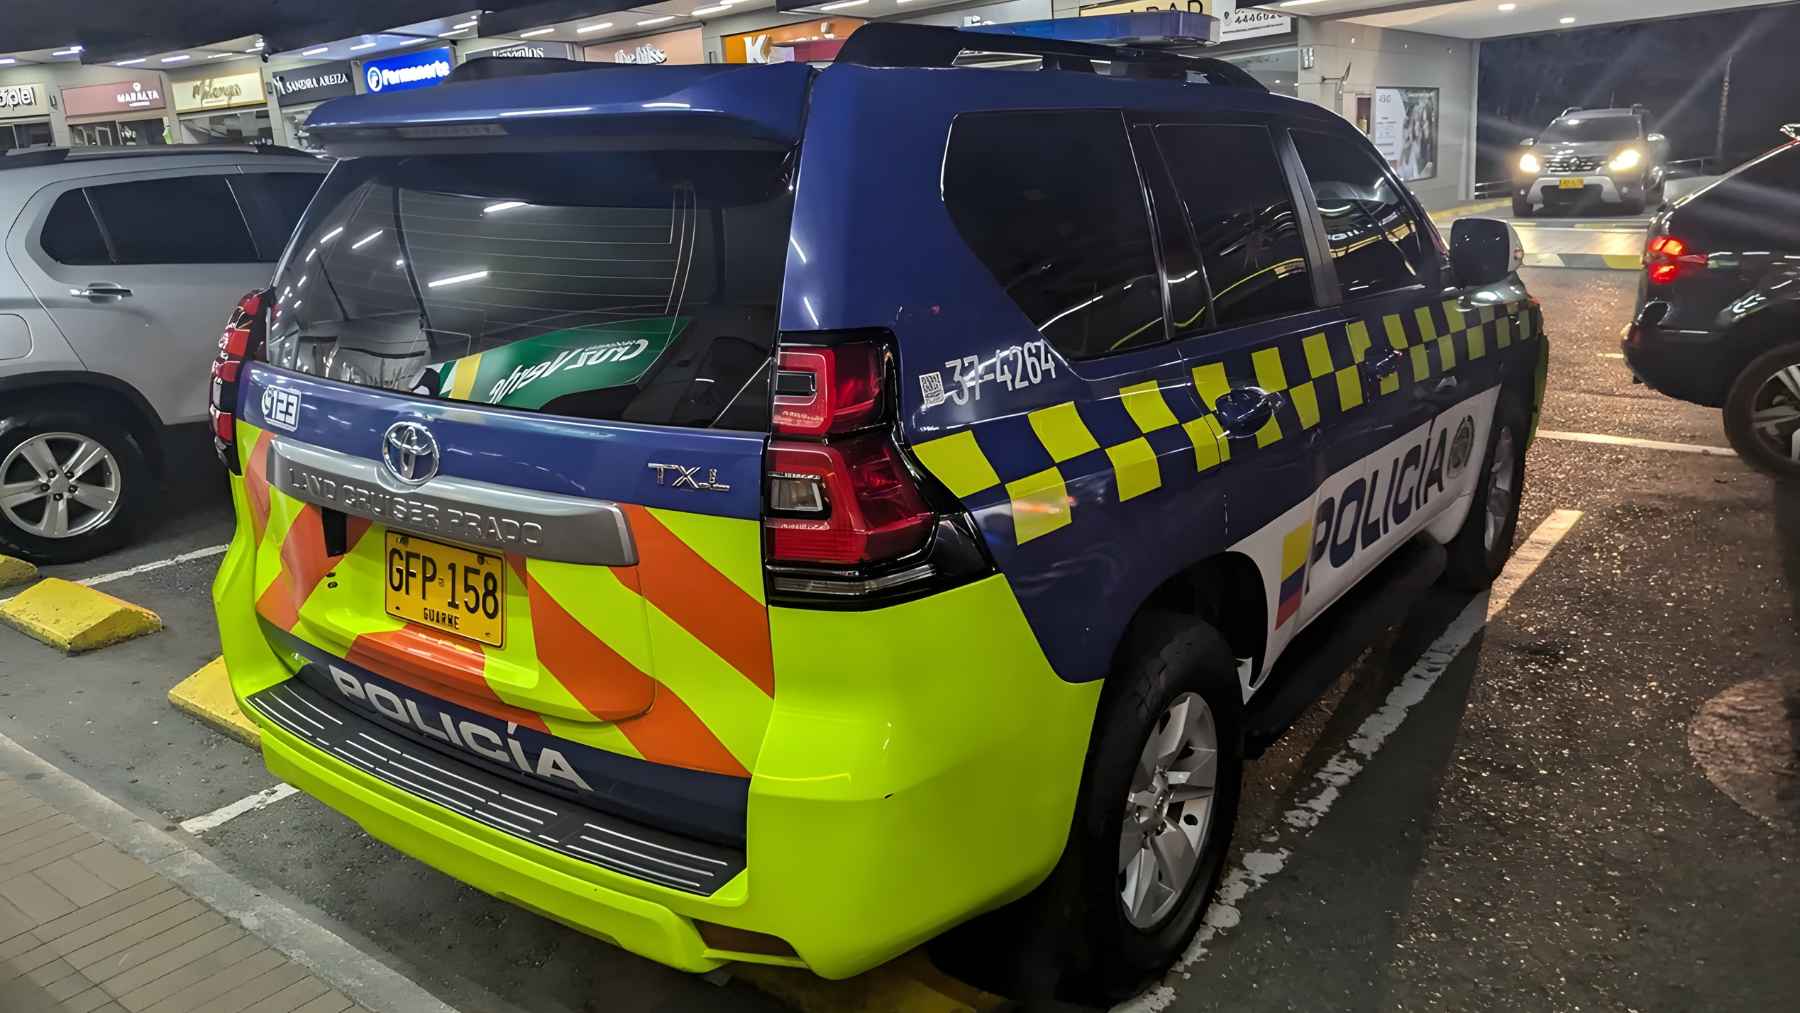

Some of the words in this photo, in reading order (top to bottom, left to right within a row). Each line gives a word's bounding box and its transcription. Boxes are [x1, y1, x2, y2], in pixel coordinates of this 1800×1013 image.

[286, 78, 319, 93] SANDRA
[272, 390, 299, 426] 123
[943, 340, 1057, 405] 37-4264
[288, 467, 337, 502] LAND
[341, 484, 440, 530] CRUISER
[446, 507, 543, 545] PRADO
[1305, 416, 1447, 592] POLICÍA
[328, 664, 592, 792] POLICÍA
